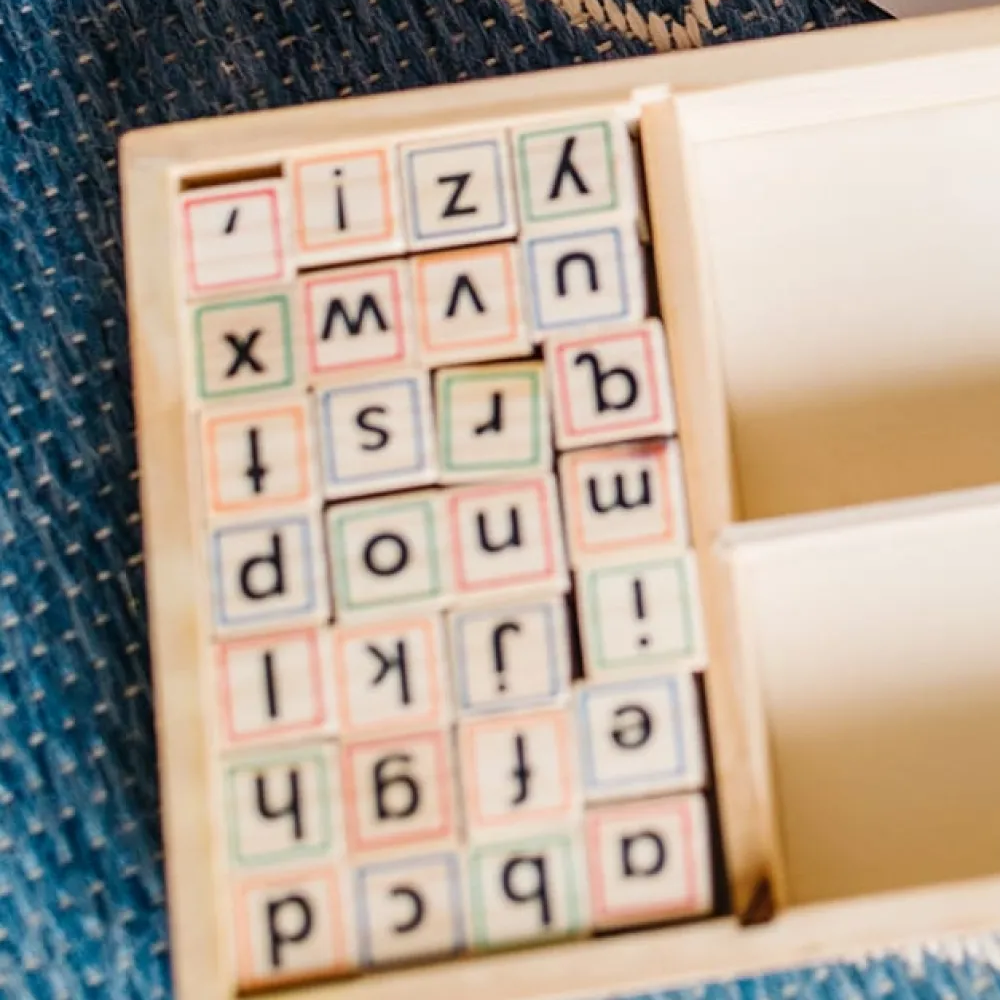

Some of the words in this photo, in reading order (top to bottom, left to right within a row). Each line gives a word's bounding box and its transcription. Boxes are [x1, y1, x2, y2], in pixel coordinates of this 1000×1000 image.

[549, 136, 589, 200] y
[438, 173, 478, 218] z
[446, 274, 485, 318] v
[224, 329, 264, 378] x
[355, 406, 389, 451] s
[474, 392, 502, 435] r
[243, 428, 268, 494] t
[363, 533, 409, 577] o
[368, 641, 410, 705] k
[611, 706, 652, 747] e
[373, 756, 420, 820] g
[508, 735, 532, 805] f
[256, 771, 303, 840] h
[621, 832, 666, 877] a
[390, 887, 425, 935] c
